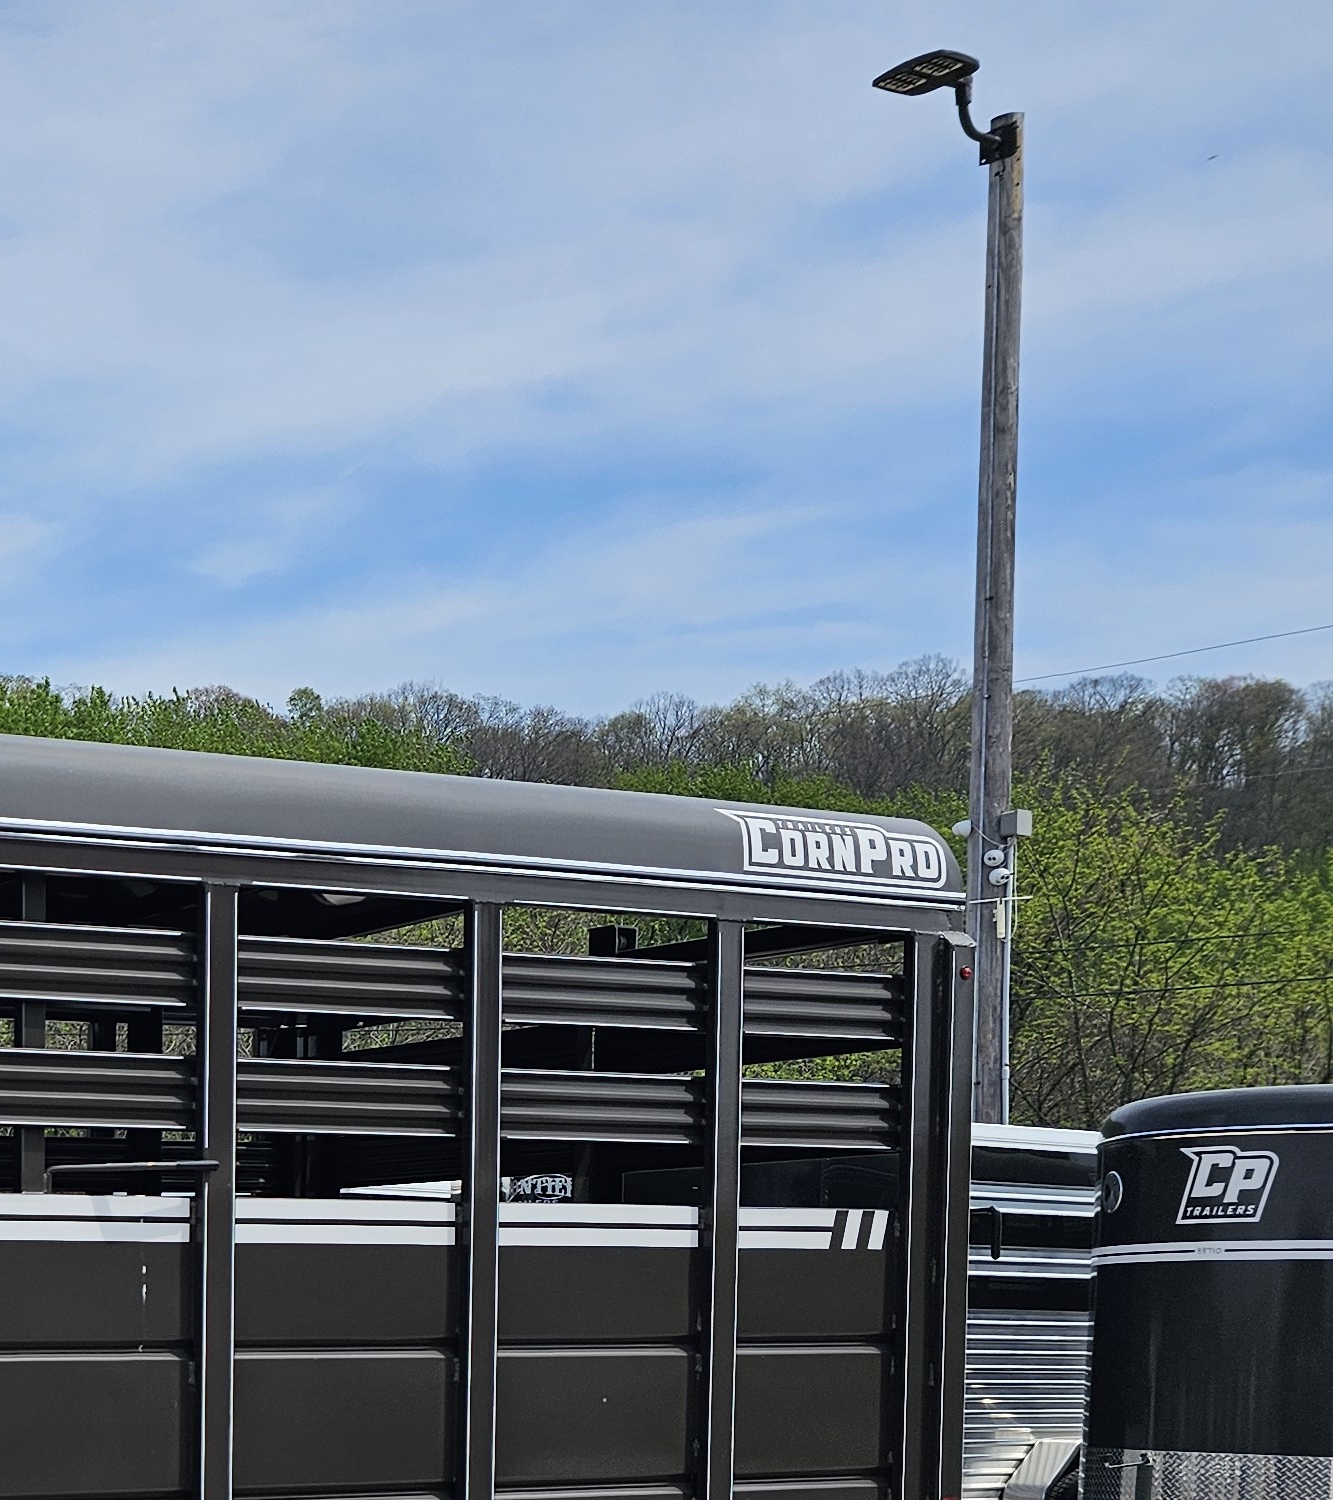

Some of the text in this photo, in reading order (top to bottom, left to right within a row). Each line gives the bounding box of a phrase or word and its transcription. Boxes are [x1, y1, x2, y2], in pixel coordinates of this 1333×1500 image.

[777, 820, 852, 835] TRAILERS
[1190, 1152, 1271, 1204] CP
[1186, 1204, 1256, 1216] TRAILERS
